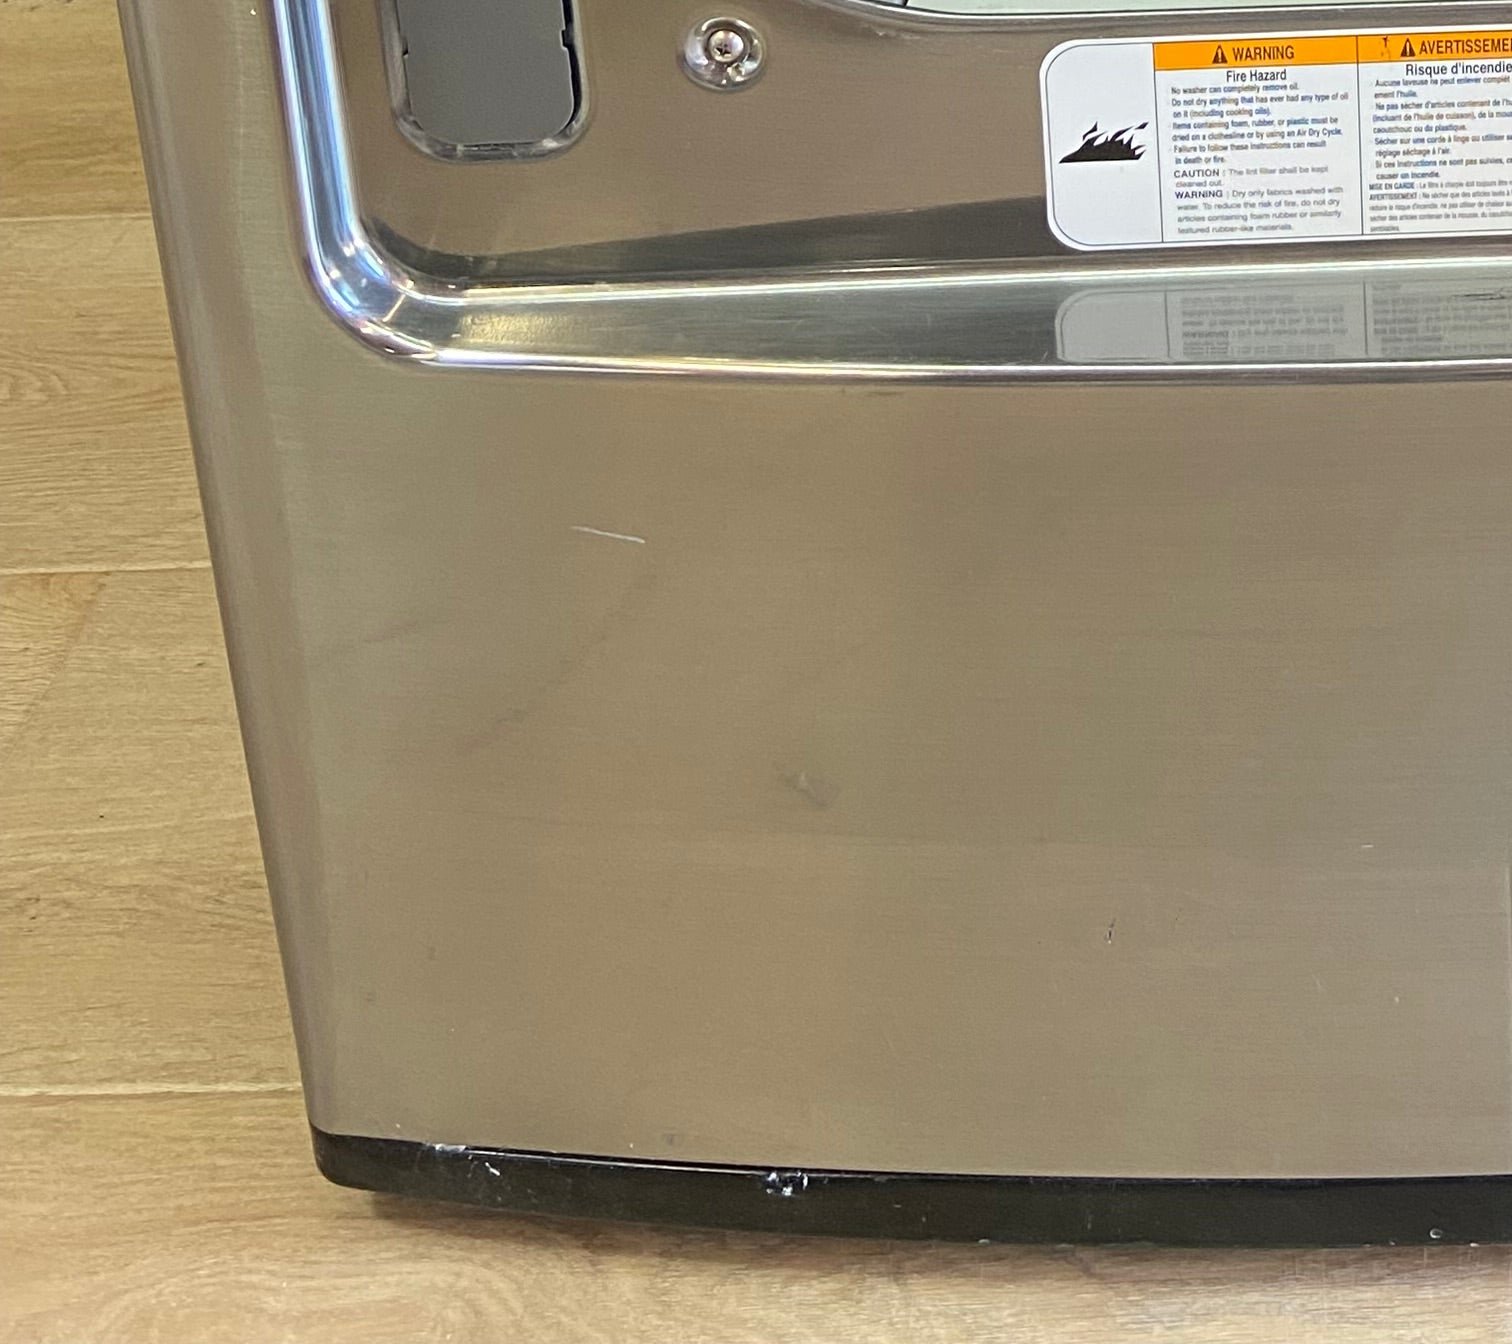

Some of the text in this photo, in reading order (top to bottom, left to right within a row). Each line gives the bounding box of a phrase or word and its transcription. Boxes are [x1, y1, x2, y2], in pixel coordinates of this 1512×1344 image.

[1232, 45, 1295, 62] WARNING
[1226, 69, 1287, 83] Fire Hazard
[1405, 62, 1512, 77] Risque d'incendie
[1174, 169, 1220, 178] CAUTION
[1175, 190, 1223, 199] WARNING
